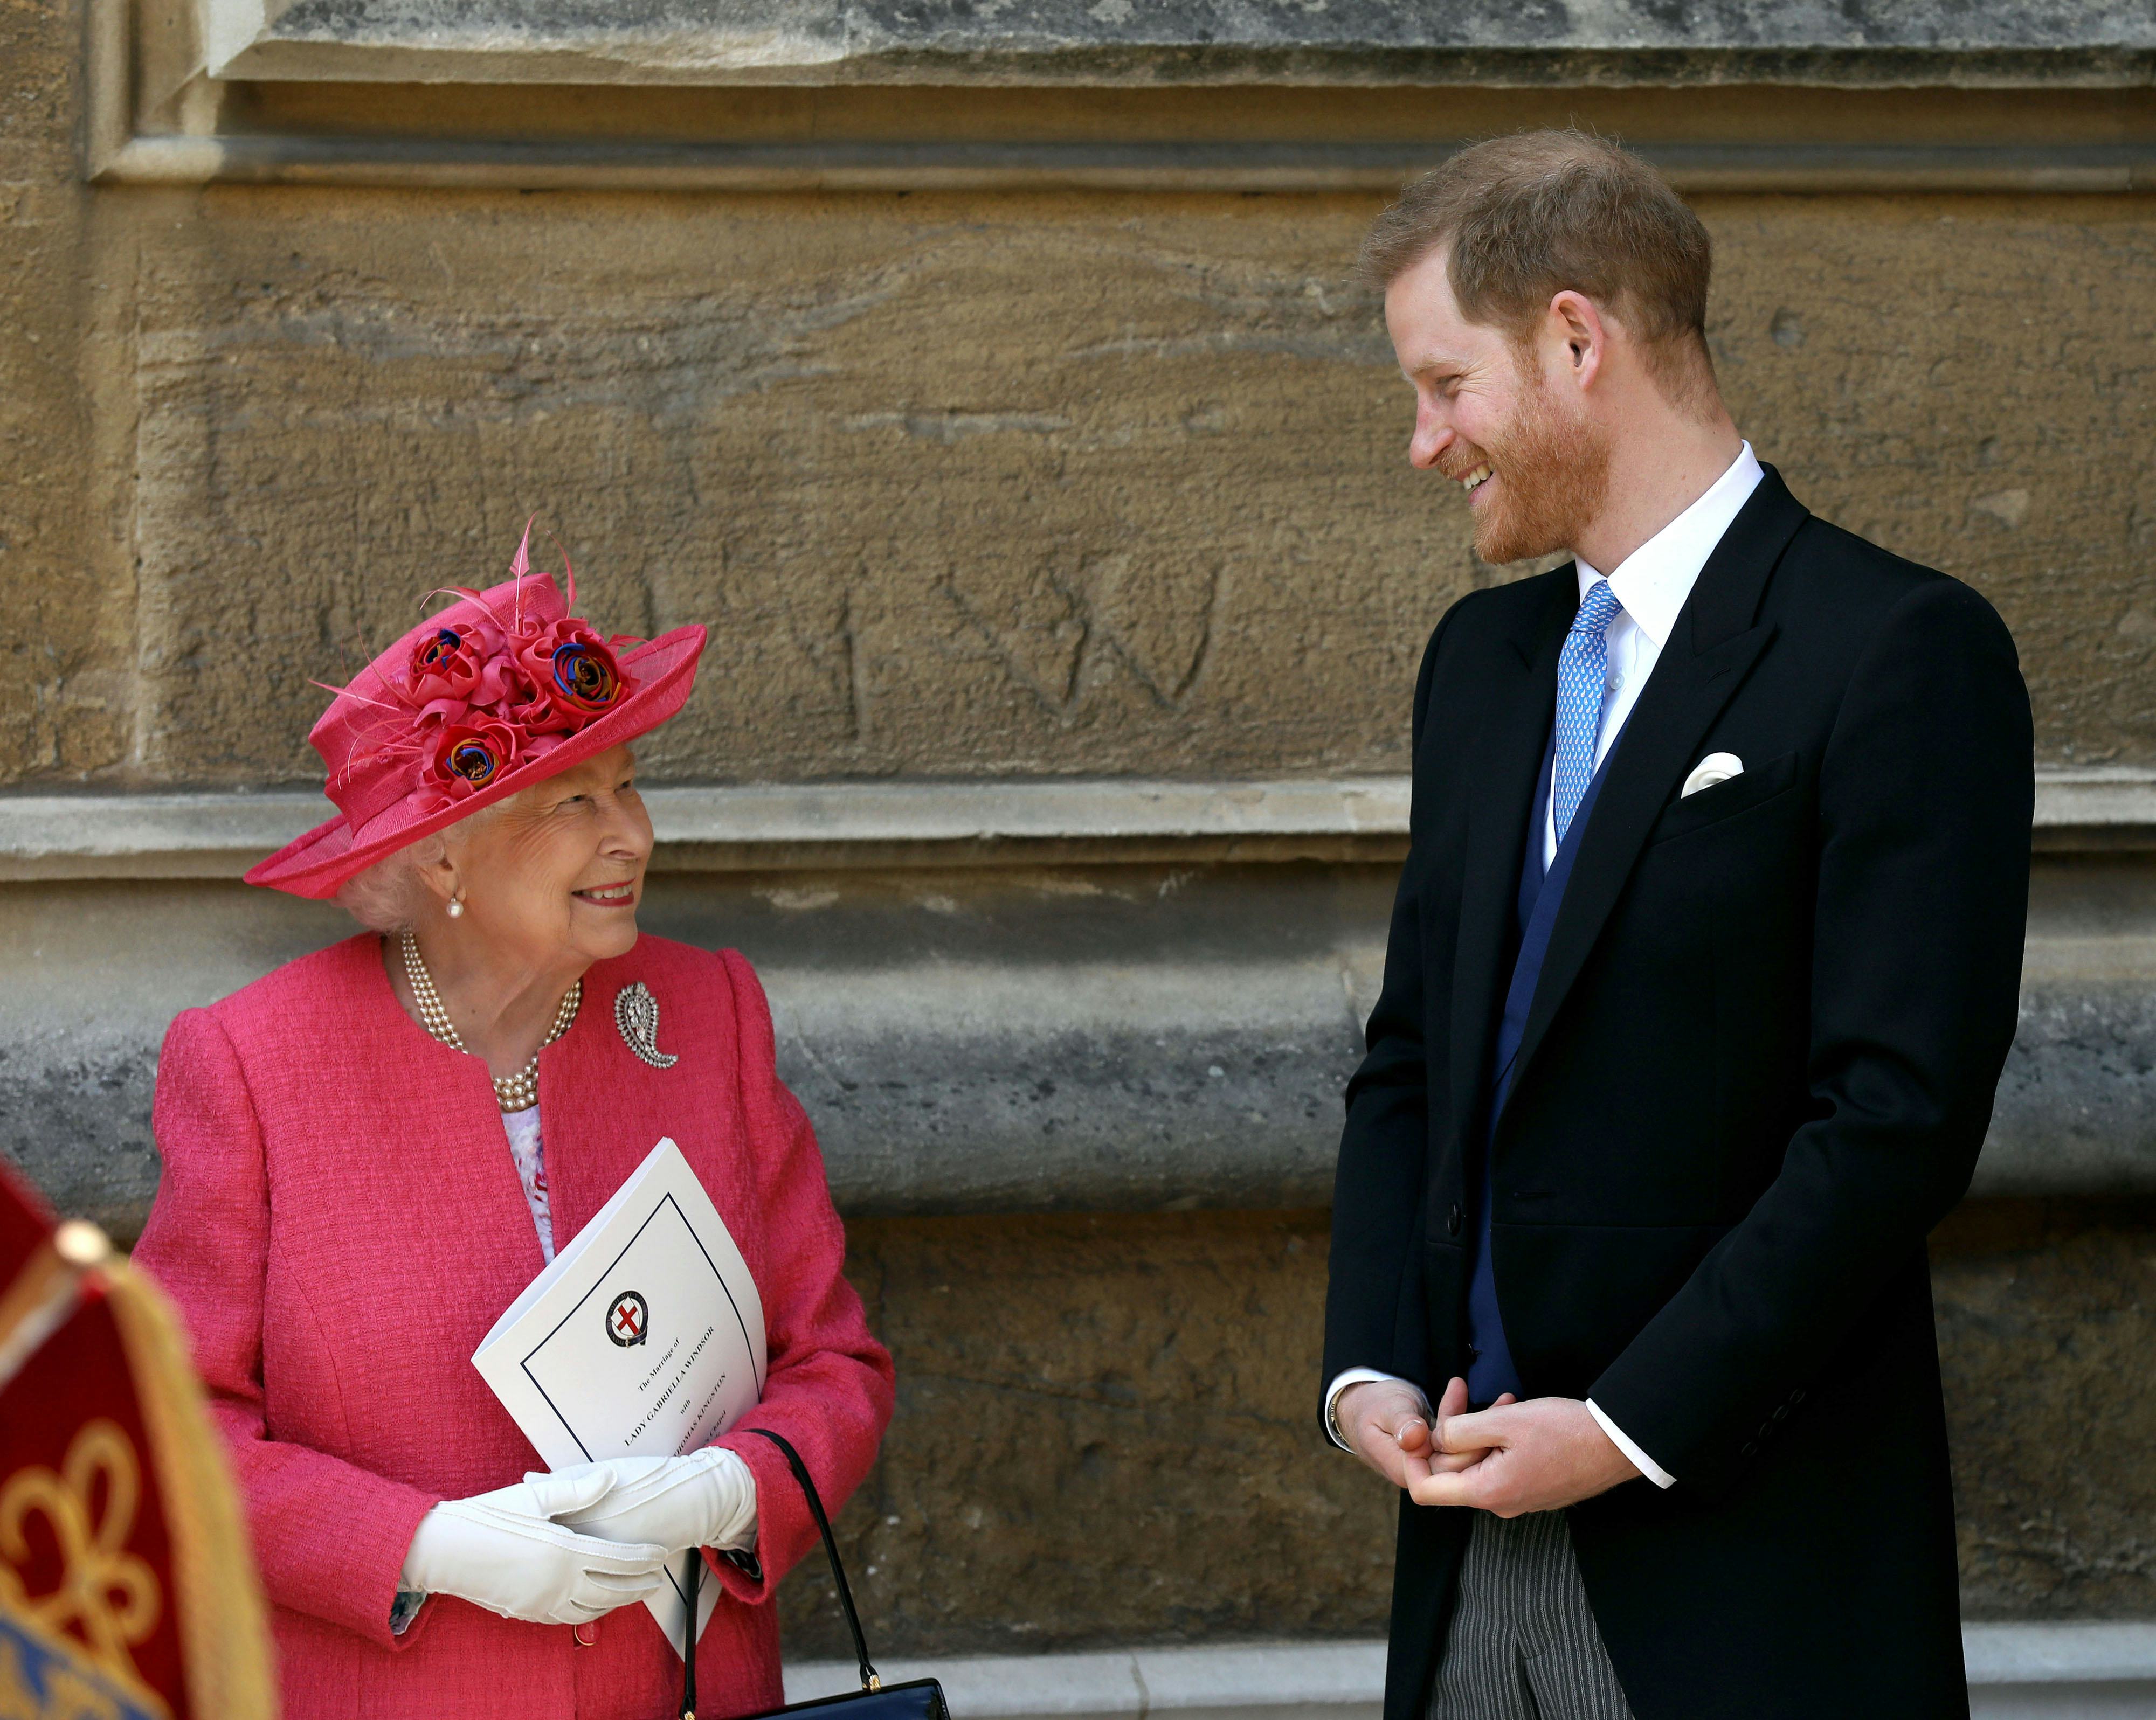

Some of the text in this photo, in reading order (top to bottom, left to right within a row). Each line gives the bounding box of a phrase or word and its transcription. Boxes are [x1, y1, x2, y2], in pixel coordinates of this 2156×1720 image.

[624, 1326, 714, 1446] LADY GABRIELLA WINDSOR
[638, 1337, 680, 1392] The Marriage of
[680, 1399, 690, 1415] with
[697, 1372, 726, 1421] KINGSTON
[710, 1410, 726, 1437] Chapel
